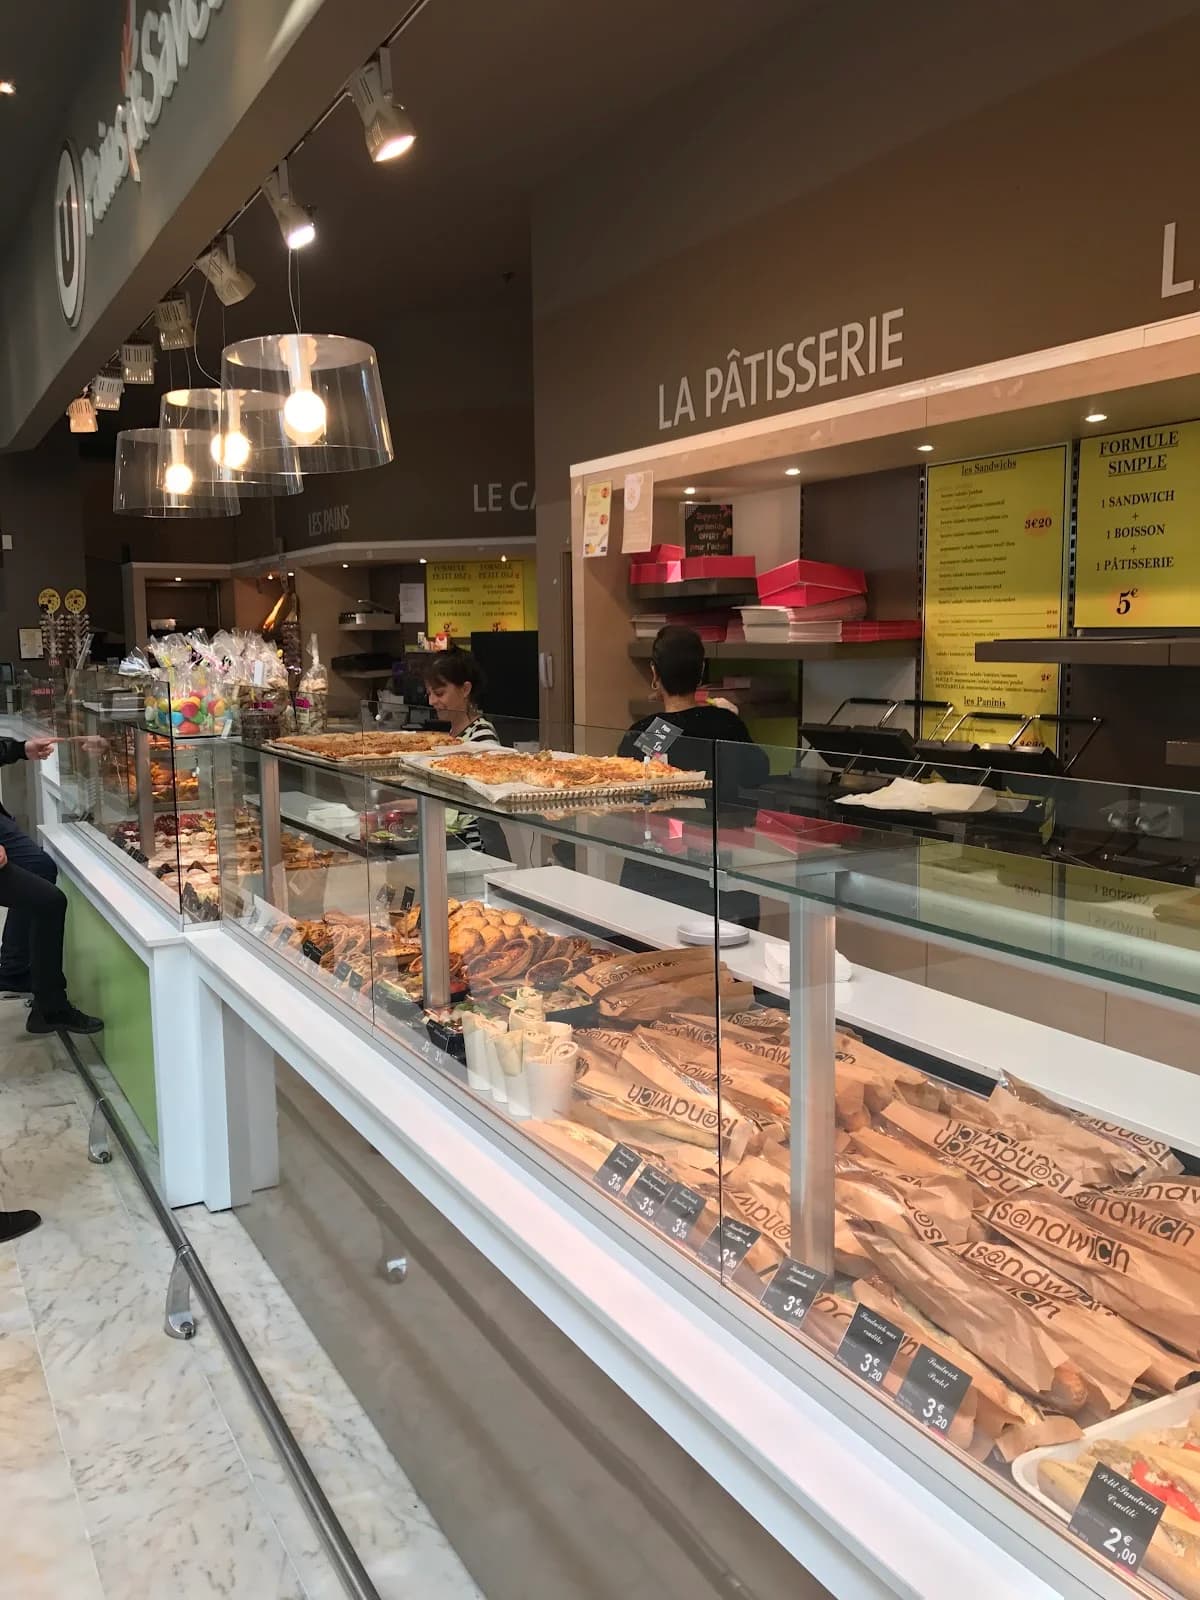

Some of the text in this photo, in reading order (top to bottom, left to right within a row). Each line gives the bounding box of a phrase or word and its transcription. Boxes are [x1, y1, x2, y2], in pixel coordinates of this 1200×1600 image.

[1161, 222, 1200, 298] L
[658, 308, 904, 430] LA PÂTISSERIE
[1100, 431, 1179, 456] FORMULE
[1108, 454, 1167, 475] SIMPLE
[474, 483, 502, 512] LE
[1108, 489, 1175, 508] SANDWICH
[308, 505, 350, 537] LES PAINS
[1114, 524, 1165, 539] BOISSON
[1104, 556, 1174, 571] PÂTISSERIE
[1097, 1472, 1159, 1516] Petit Sandwich
